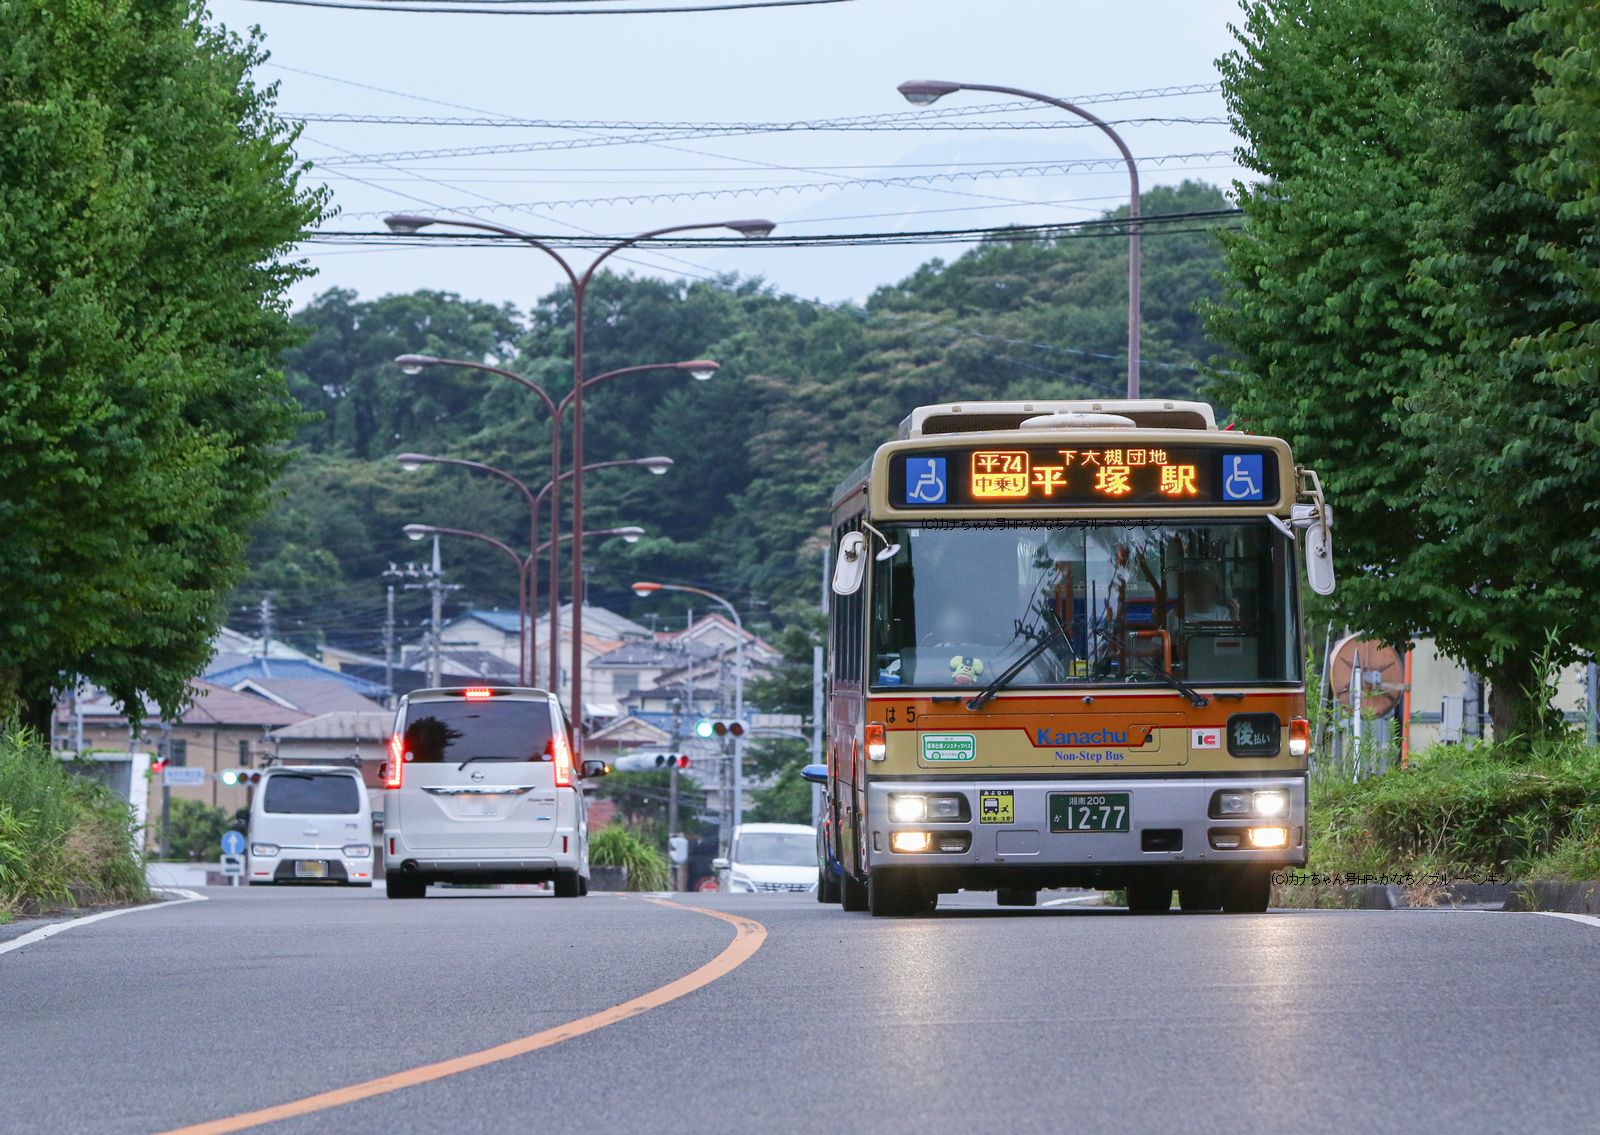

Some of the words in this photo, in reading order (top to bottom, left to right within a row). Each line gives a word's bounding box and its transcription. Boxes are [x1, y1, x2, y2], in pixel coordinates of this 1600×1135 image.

[977, 454, 1022, 473] 平74
[1058, 449, 1168, 466] 下大槻団地
[975, 476, 1026, 493] 中乗り
[1032, 465, 1198, 496] 平塚駅
[885, 706, 896, 723] は
[907, 706, 916, 723] 5
[1037, 727, 1127, 745] Kanachu
[1234, 720, 1271, 746] 後払い
[1055, 751, 1103, 763] Non-Step
[1105, 751, 1125, 761] Bus
[1069, 796, 1086, 806] 湘南
[1087, 796, 1106, 805] 200
